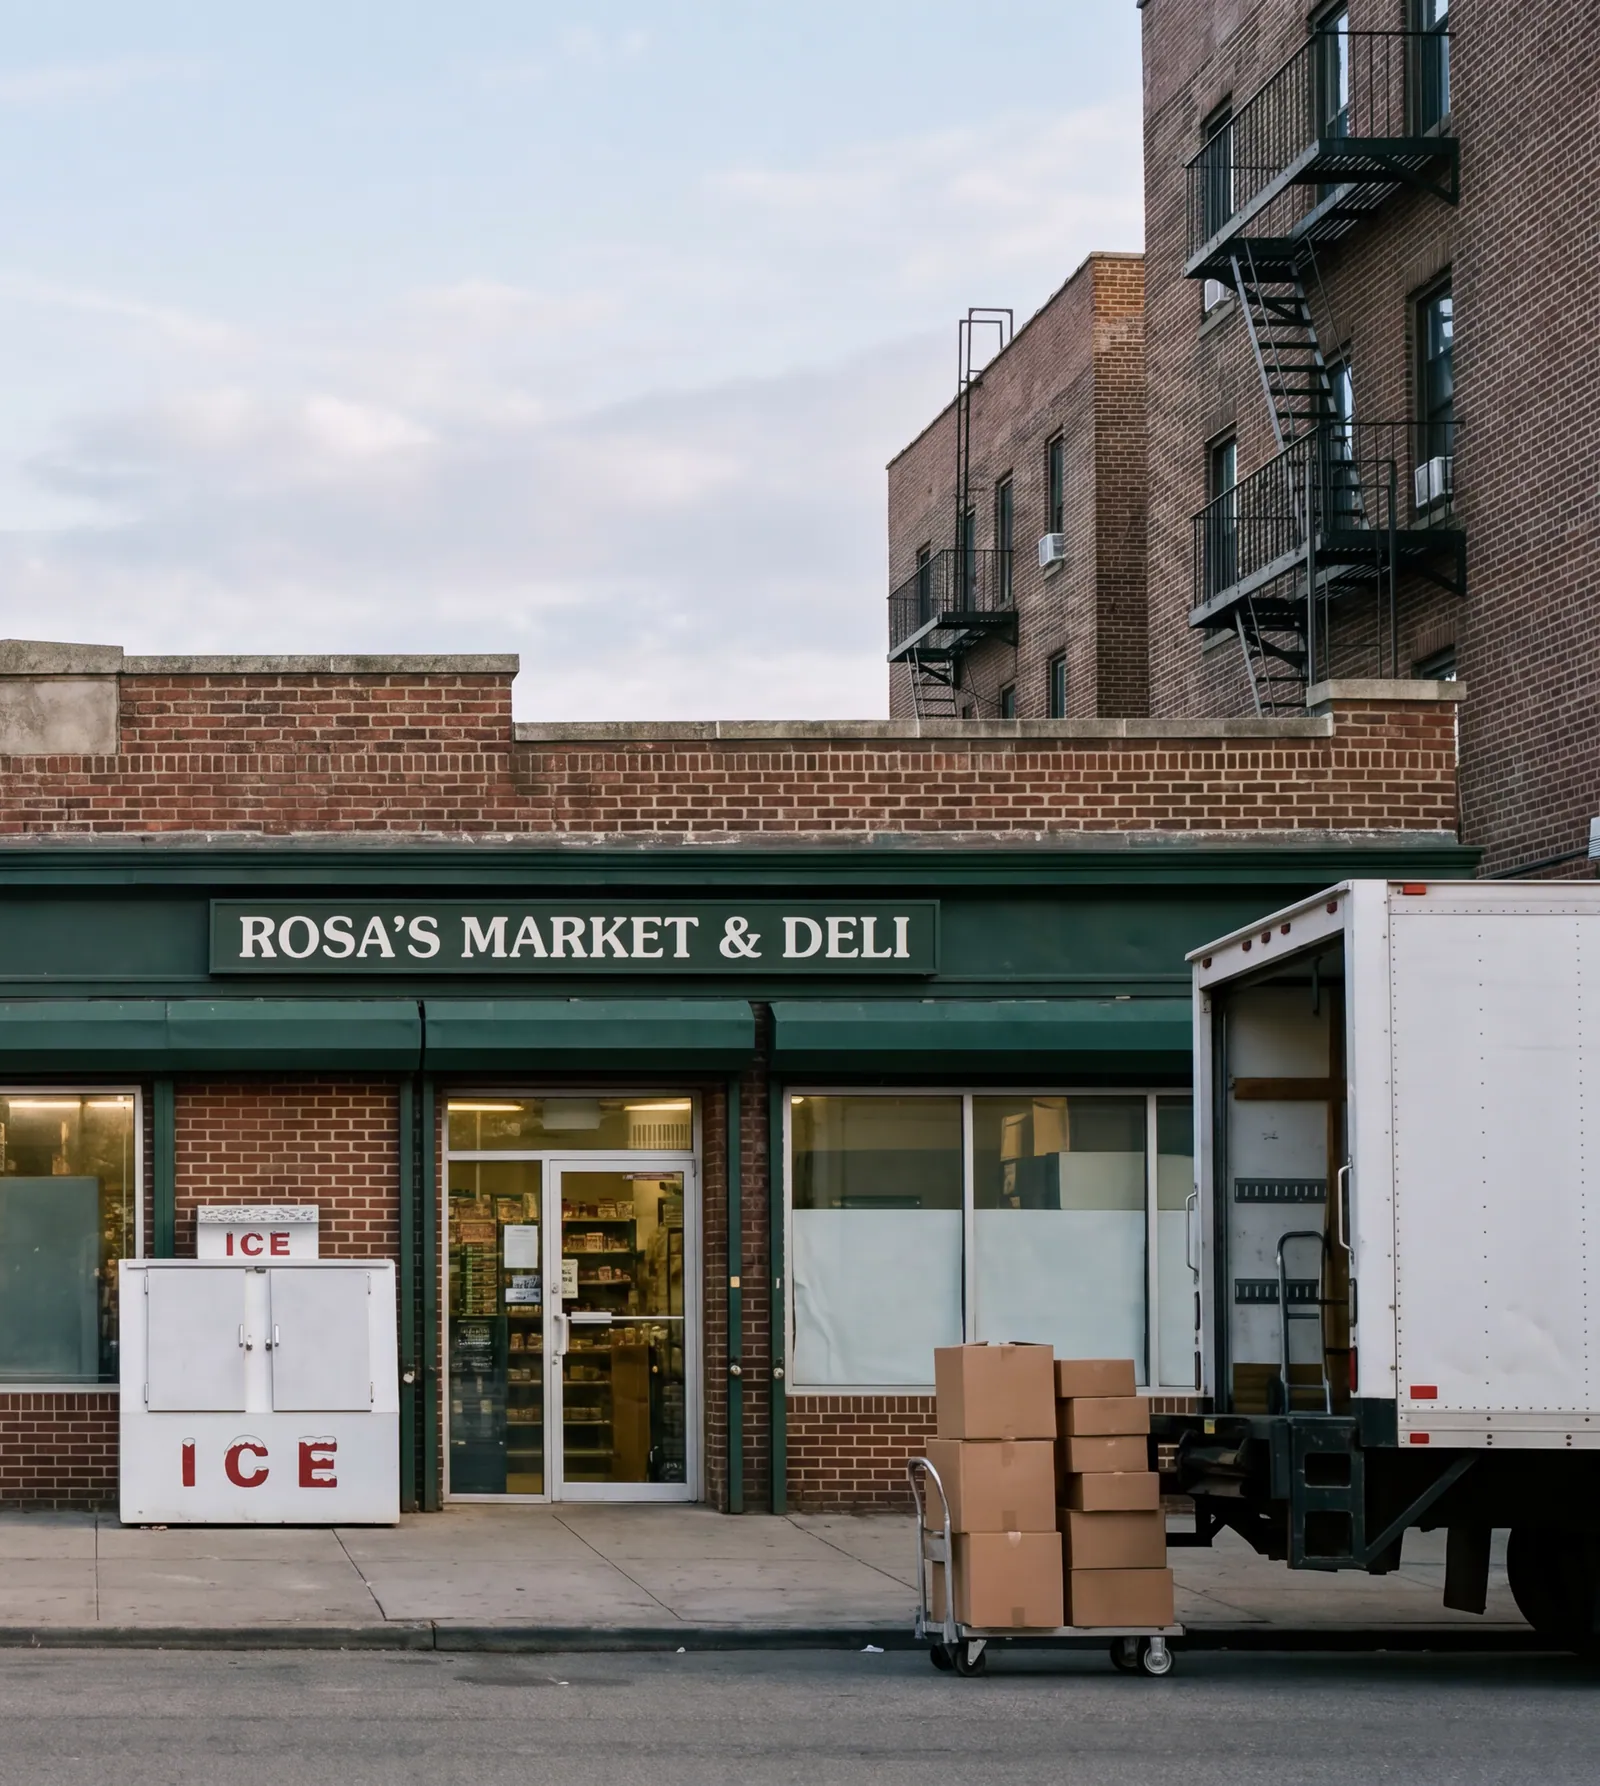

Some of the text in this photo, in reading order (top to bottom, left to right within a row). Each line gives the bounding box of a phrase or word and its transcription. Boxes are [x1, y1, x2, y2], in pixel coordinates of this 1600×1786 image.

[238, 915, 912, 959] ROSA'S MARKET & DELI
[225, 1231, 291, 1257] ICE
[181, 1436, 338, 1489] ICE
